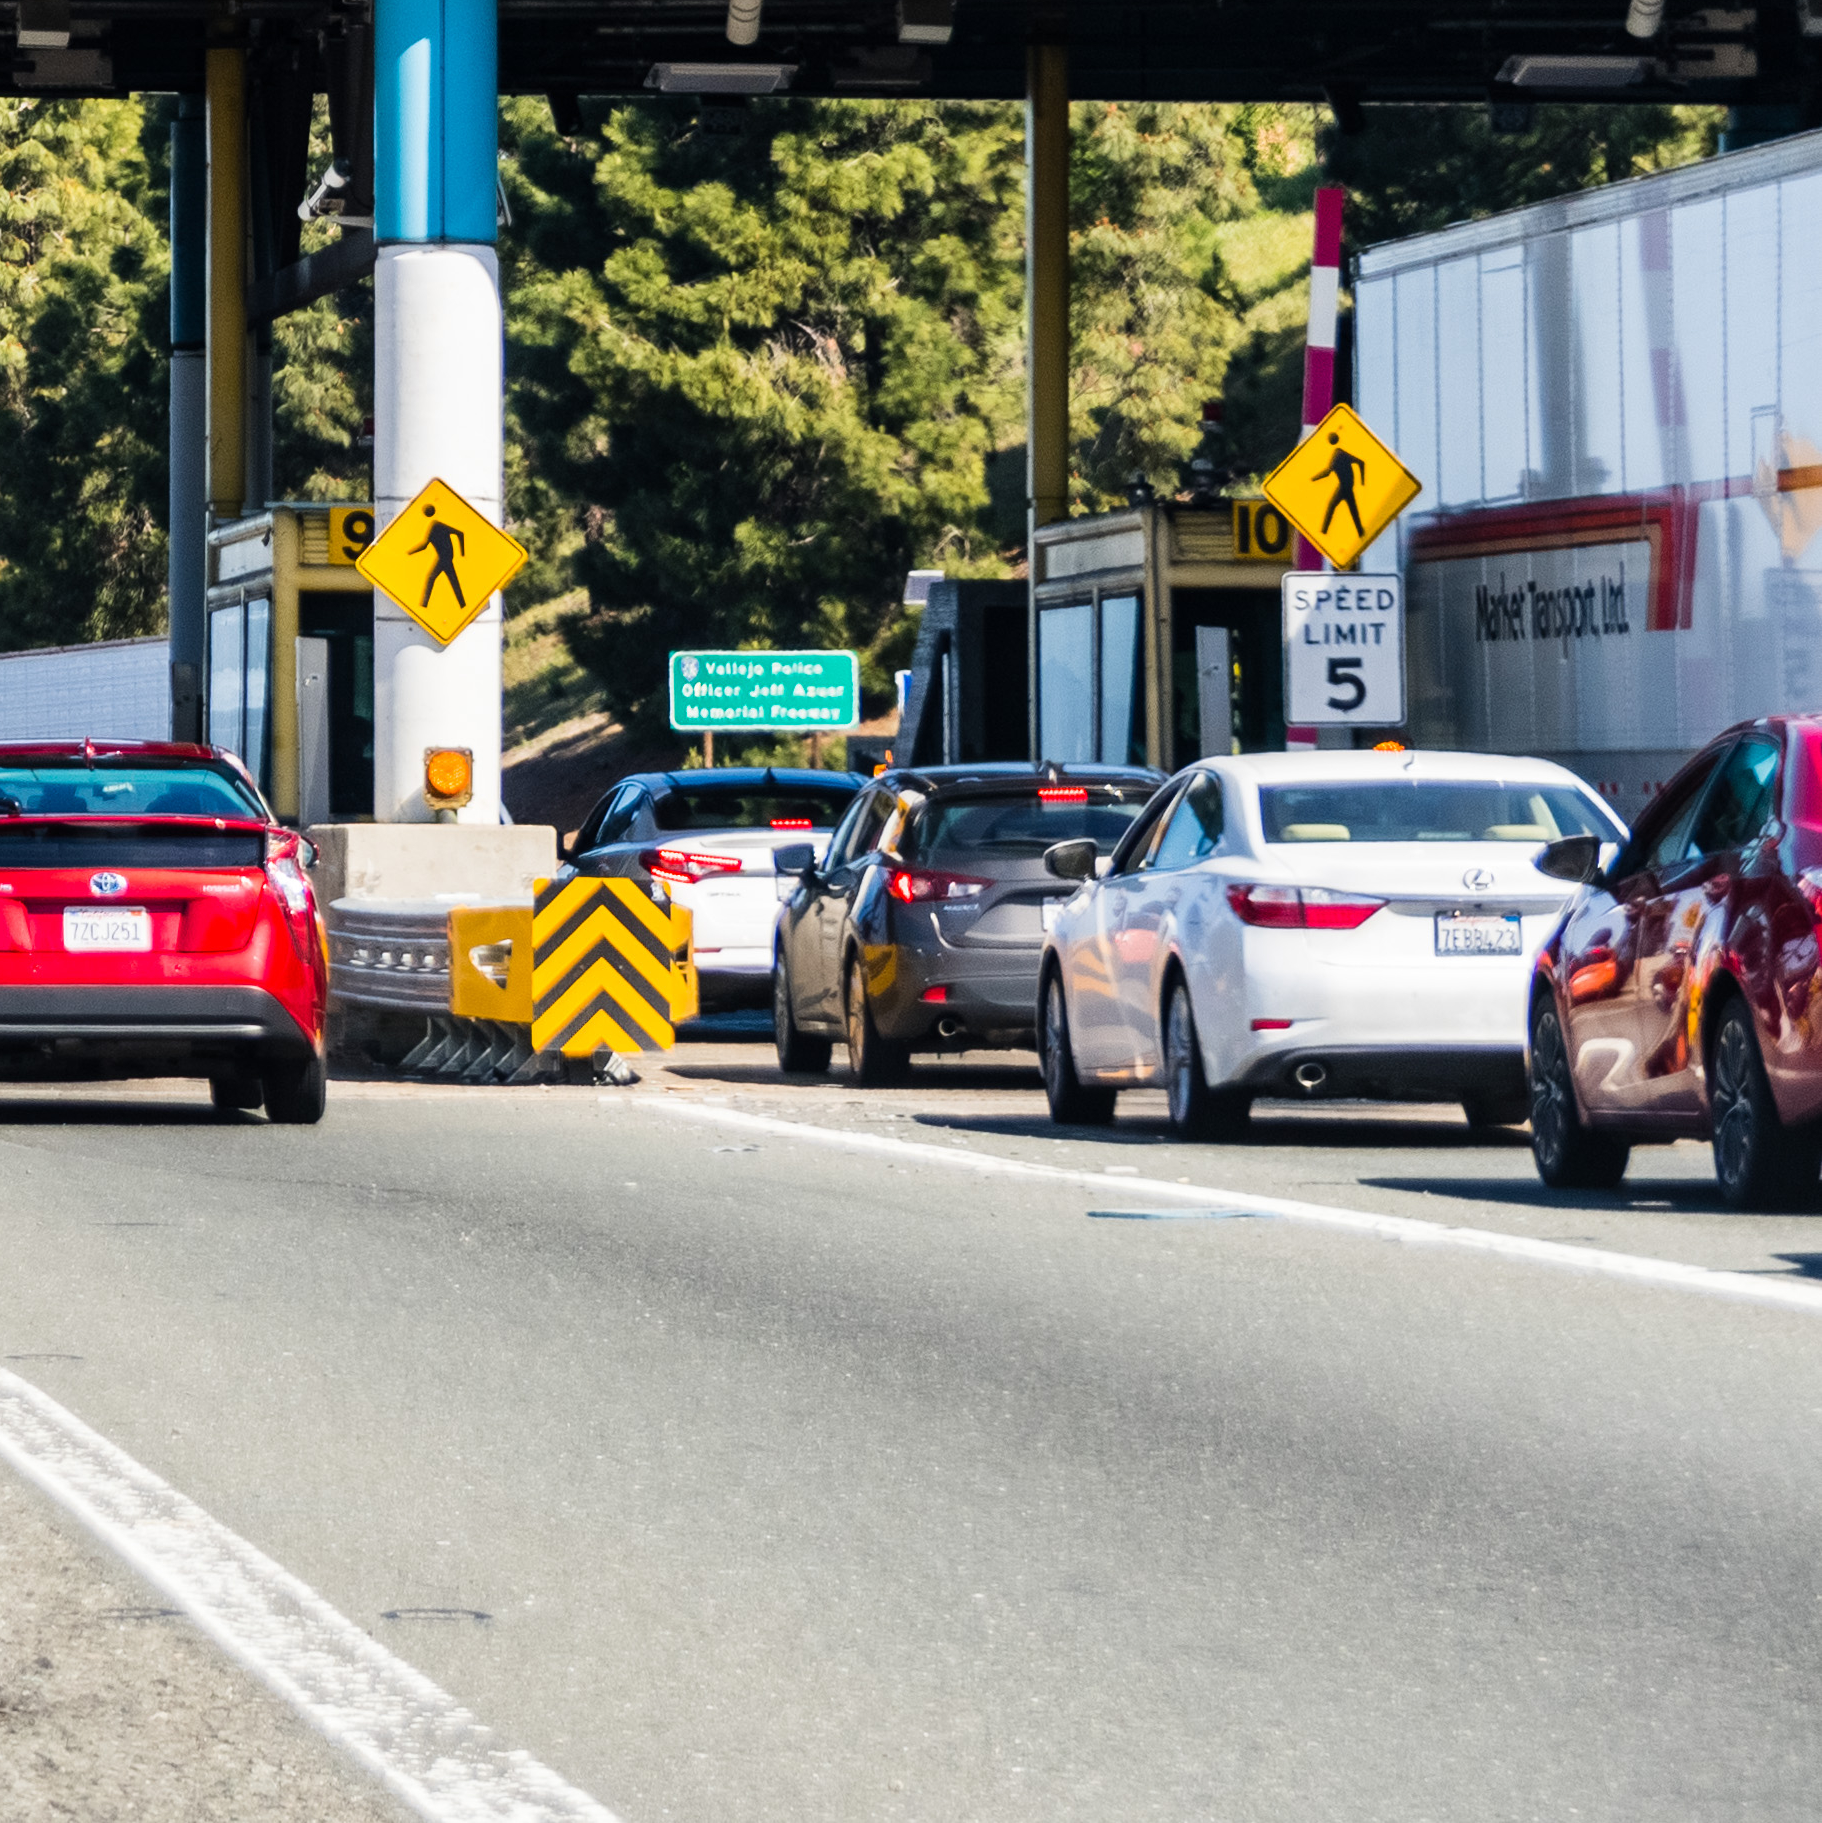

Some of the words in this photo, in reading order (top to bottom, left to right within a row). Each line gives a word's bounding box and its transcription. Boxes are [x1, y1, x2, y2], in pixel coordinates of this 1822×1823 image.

[342, 510, 375, 562] 9
[1238, 504, 1288, 554] 10
[1295, 587, 1394, 610] SPEED
[1476, 571, 1525, 641] Market
[1304, 623, 1385, 645] LIMIT
[705, 662, 764, 679] Vallejo
[771, 662, 823, 675] Police
[682, 682, 741, 697] Officer
[1327, 658, 1366, 711] 5
[686, 704, 764, 719] Memorial
[770, 704, 841, 720] Freeway
[70, 922, 141, 941] 7ZCJ251
